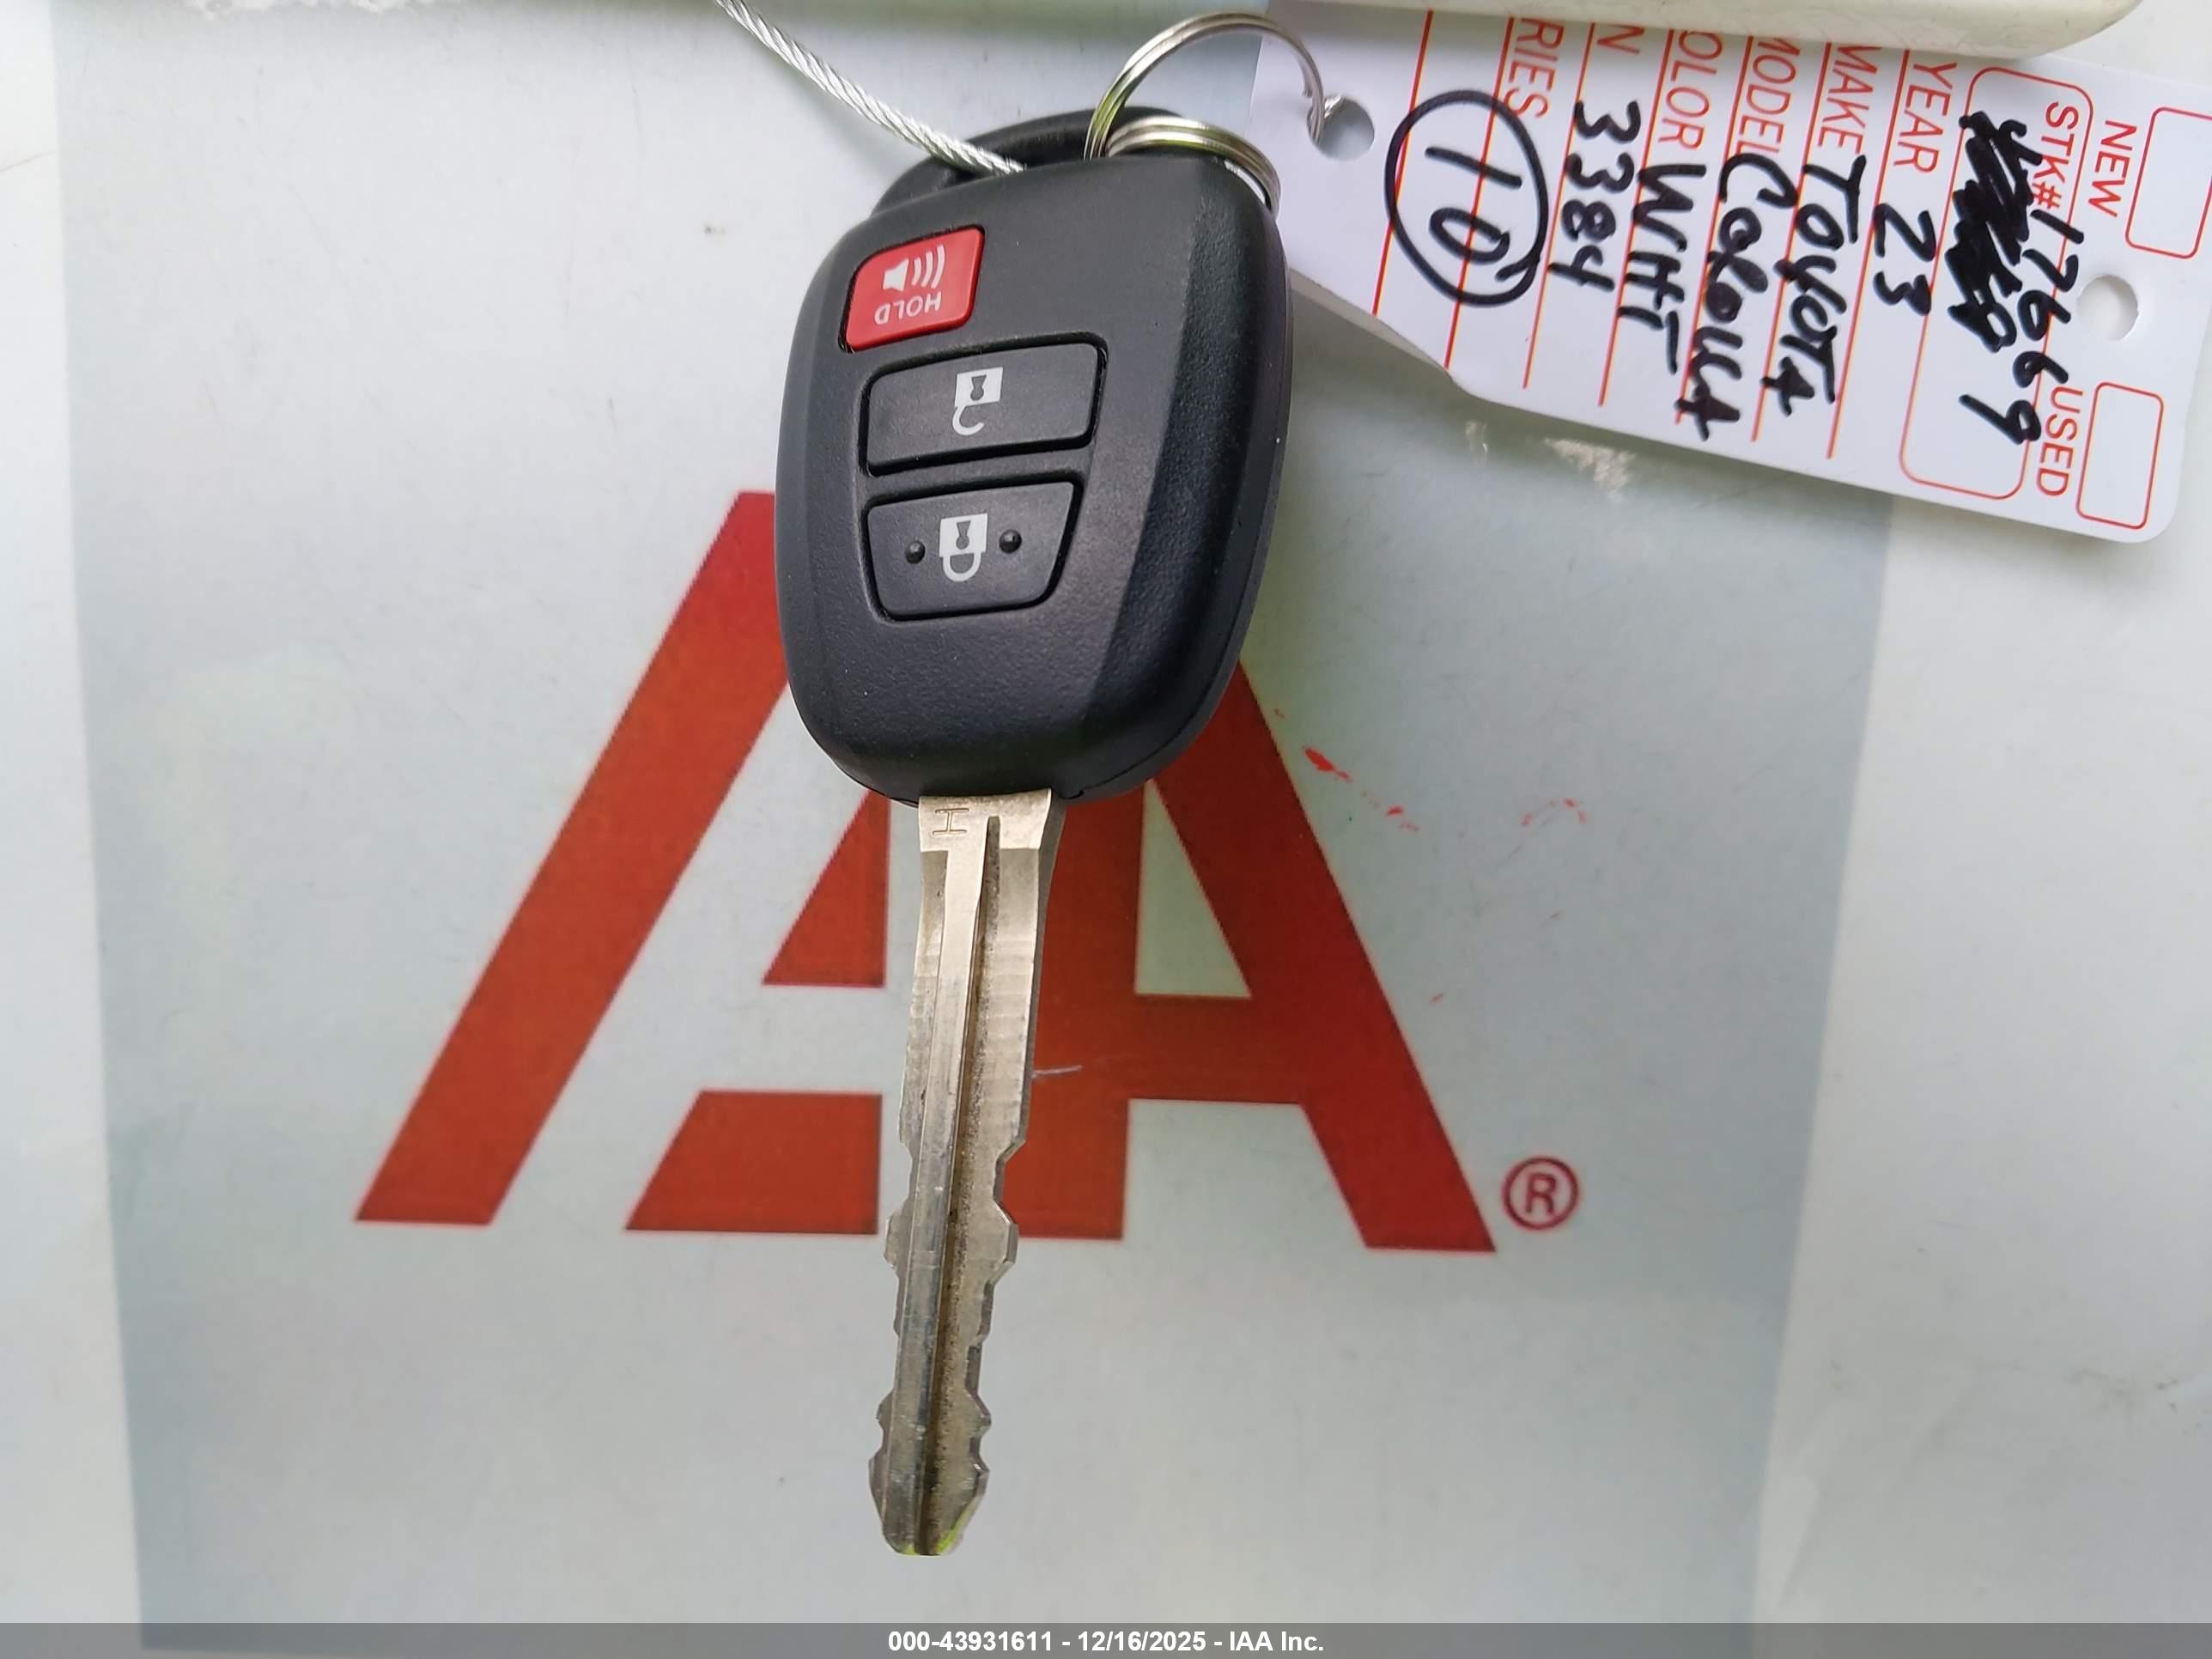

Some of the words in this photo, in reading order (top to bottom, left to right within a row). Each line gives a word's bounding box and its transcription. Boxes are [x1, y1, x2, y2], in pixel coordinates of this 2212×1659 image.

[1507, 17, 1565, 118] RIES
[1658, 31, 1723, 151] OLOR
[1893, 62, 1957, 173] YEAR
[1425, 147, 1522, 264] 10
[1547, 100, 1641, 292] 3384
[2032, 101, 2079, 209] STK#
[2088, 119, 2137, 218] NEW
[874, 291, 941, 325] HOLD
[1618, 163, 1707, 374] WHT
[1873, 204, 1936, 315] 23
[1959, 210, 2085, 445] 17669
[2037, 387, 2083, 496] USED
